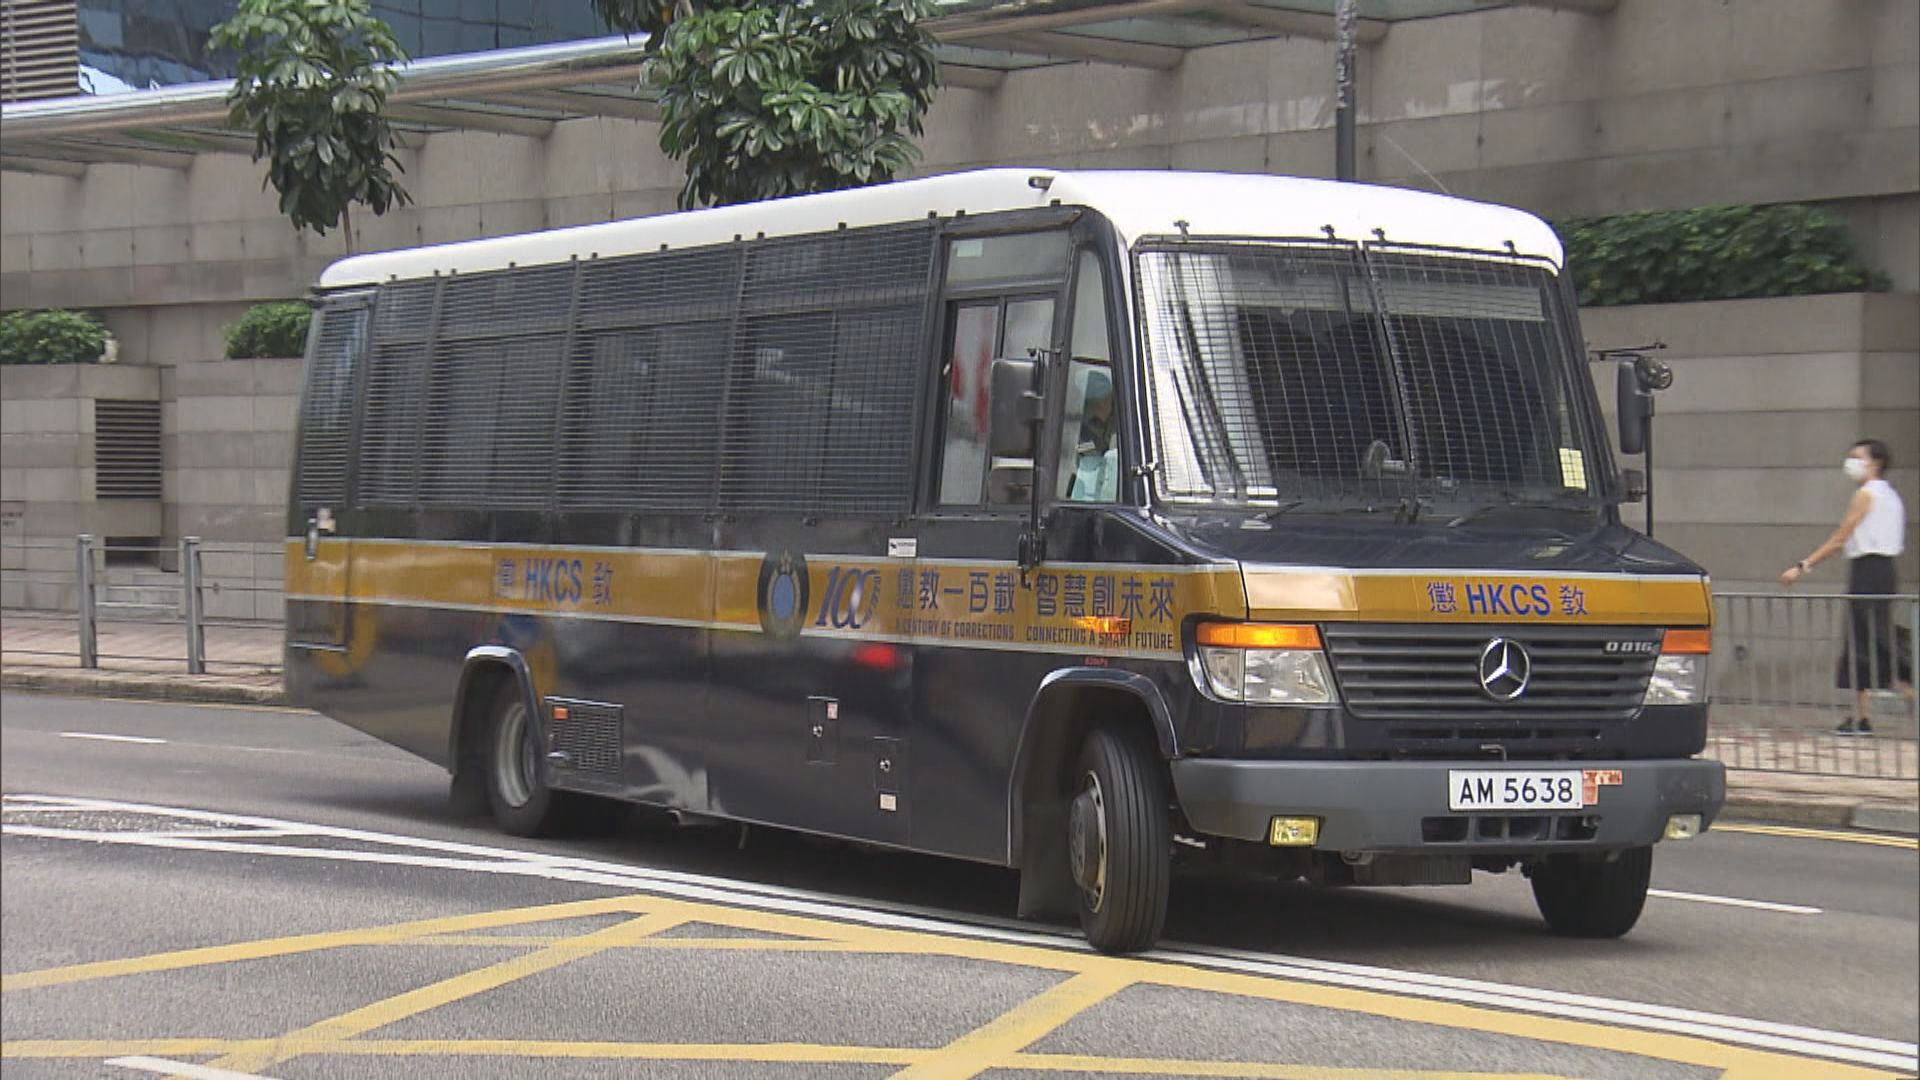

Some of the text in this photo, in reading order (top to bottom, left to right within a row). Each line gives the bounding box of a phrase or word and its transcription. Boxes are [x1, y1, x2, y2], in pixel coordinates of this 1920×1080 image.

[525, 558, 583, 603] HKCS
[1036, 573, 1176, 624] 智慧創未來
[1426, 581, 1457, 614] 懲
[1465, 583, 1551, 616] HKCS
[941, 620, 953, 637] OF
[954, 621, 1015, 641] CORRECTIONS
[1026, 625, 1087, 644] CONNECTING
[1089, 629, 1096, 646] A
[1099, 632, 1132, 648] SMART
[1135, 631, 1174, 650] FUTURE
[1459, 777, 1494, 804] AM
[1503, 777, 1574, 804] 5638
